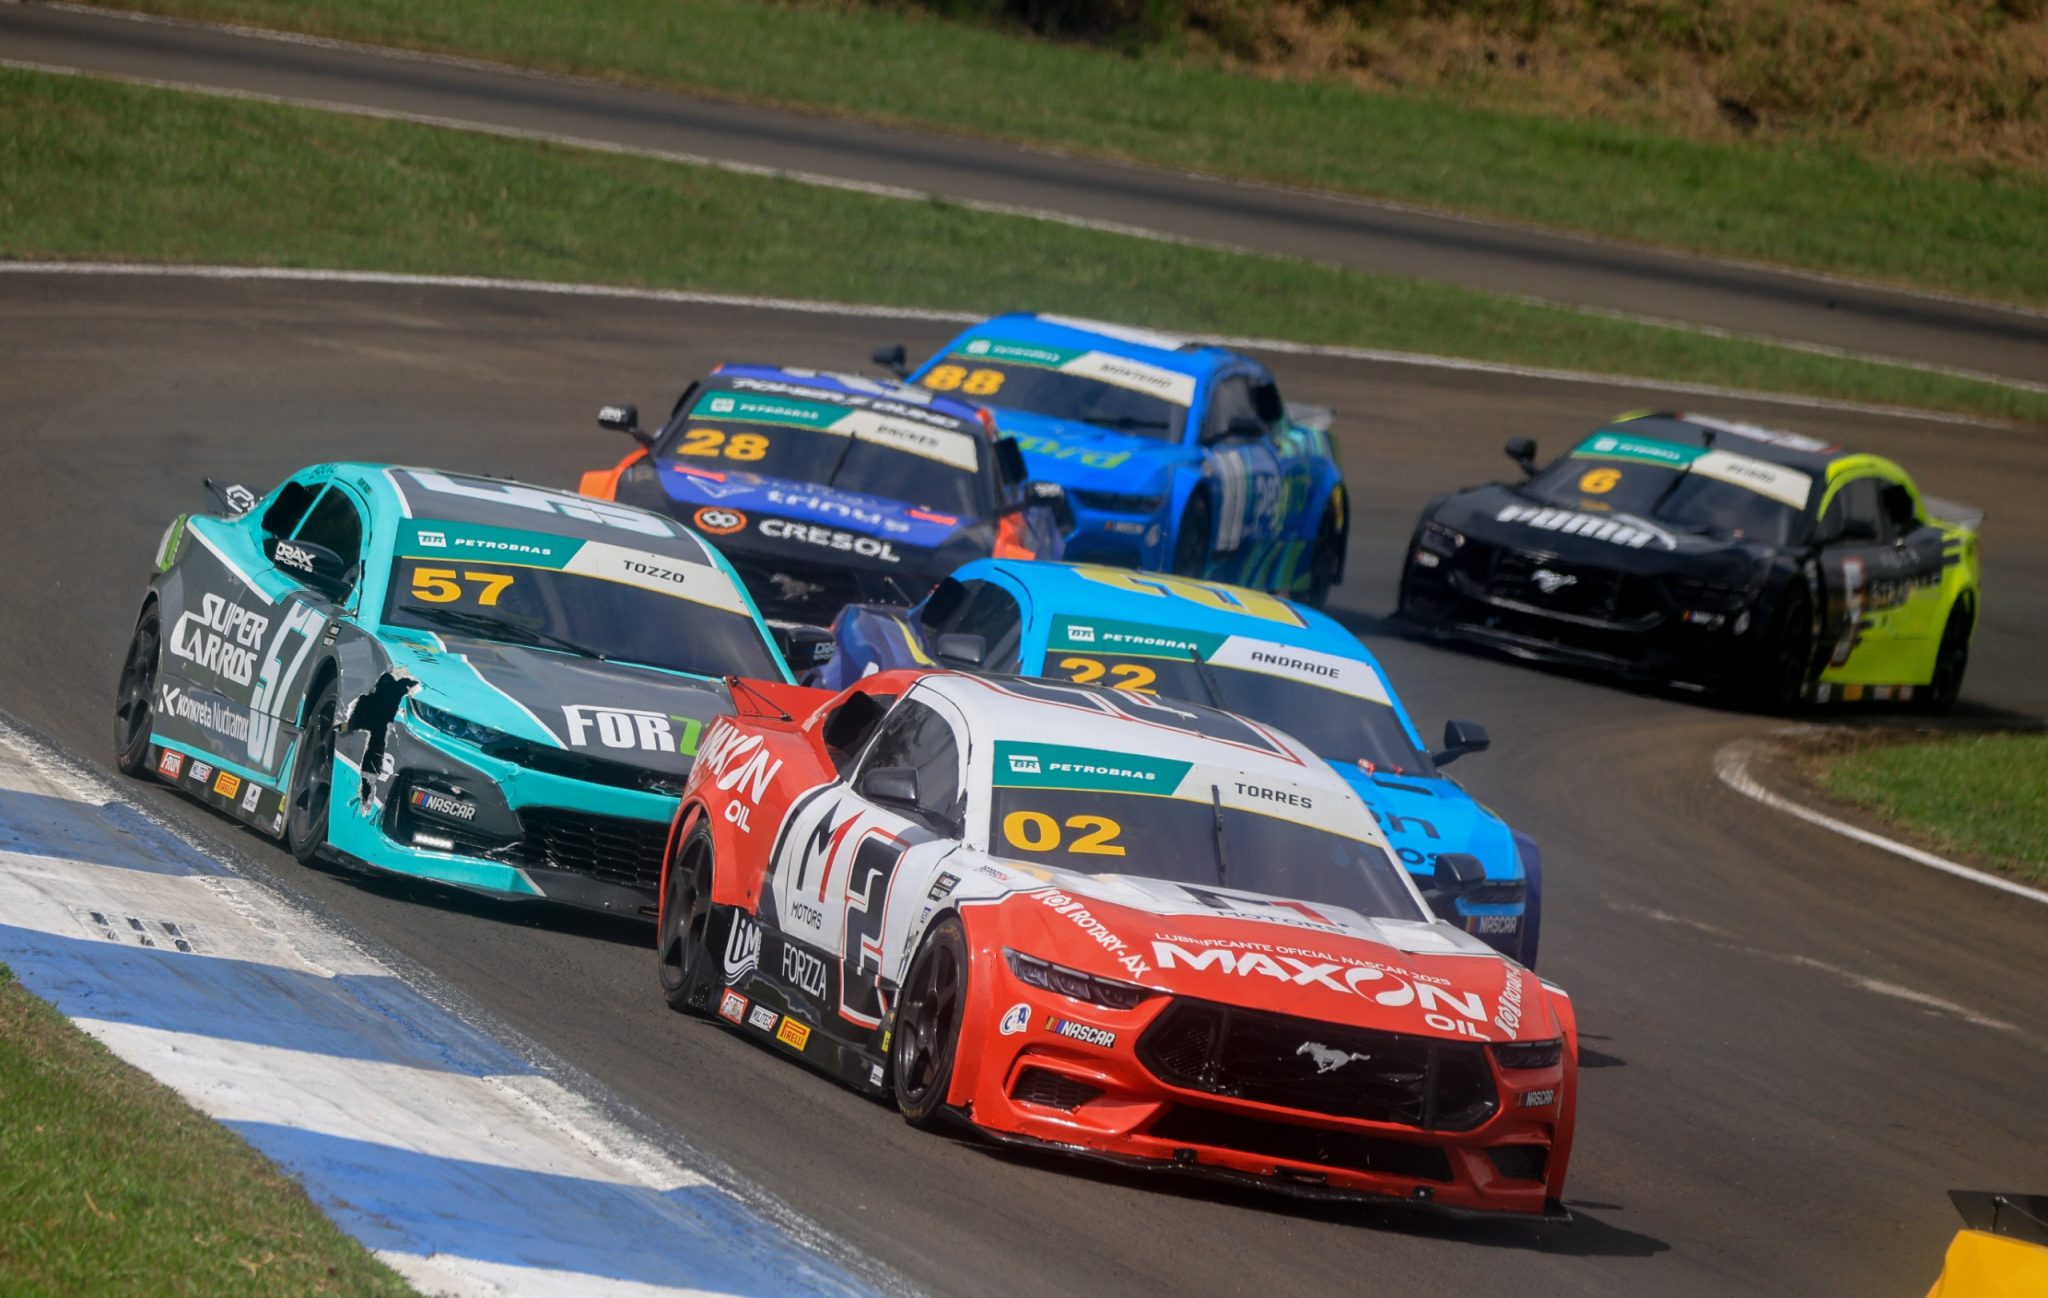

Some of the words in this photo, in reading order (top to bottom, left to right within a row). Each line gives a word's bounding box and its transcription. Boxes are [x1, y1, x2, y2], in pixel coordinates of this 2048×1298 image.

[924, 365, 1005, 395] 88
[676, 428, 770, 461] 28
[1579, 467, 1623, 494] 6
[275, 542, 316, 567] DRAX
[454, 538, 552, 556] PETROBRAS
[758, 518, 901, 563] CRESOL
[623, 559, 685, 584] TOZZO
[410, 567, 515, 606] 57
[200, 592, 268, 651] SUPER
[170, 610, 257, 687] CARROS
[1103, 632, 1198, 650] PETROBRAS
[1059, 657, 1157, 695] 22
[1250, 651, 1341, 679] ANDRADE
[1050, 763, 1156, 781] PETROBRAS
[426, 795, 476, 821] NASCAR
[1235, 782, 1313, 809] TORRES
[724, 799, 751, 834] OIL
[1003, 811, 1126, 856] 02
[791, 902, 822, 930] MOTORS
[1477, 916, 1517, 934] NASCAR
[782, 942, 827, 1001] FORZZA
[1154, 932, 1272, 952] LUBRIFICANTE
[1276, 945, 1341, 963] OFICIAL
[1341, 956, 1408, 977] NASCAR
[1411, 971, 1452, 986] 2025
[1151, 941, 1489, 1023] MAXON
[781, 1021, 809, 1045] PIRELLI
[1060, 1020, 1116, 1047] NASCAR
[1424, 1013, 1492, 1043] OIL
